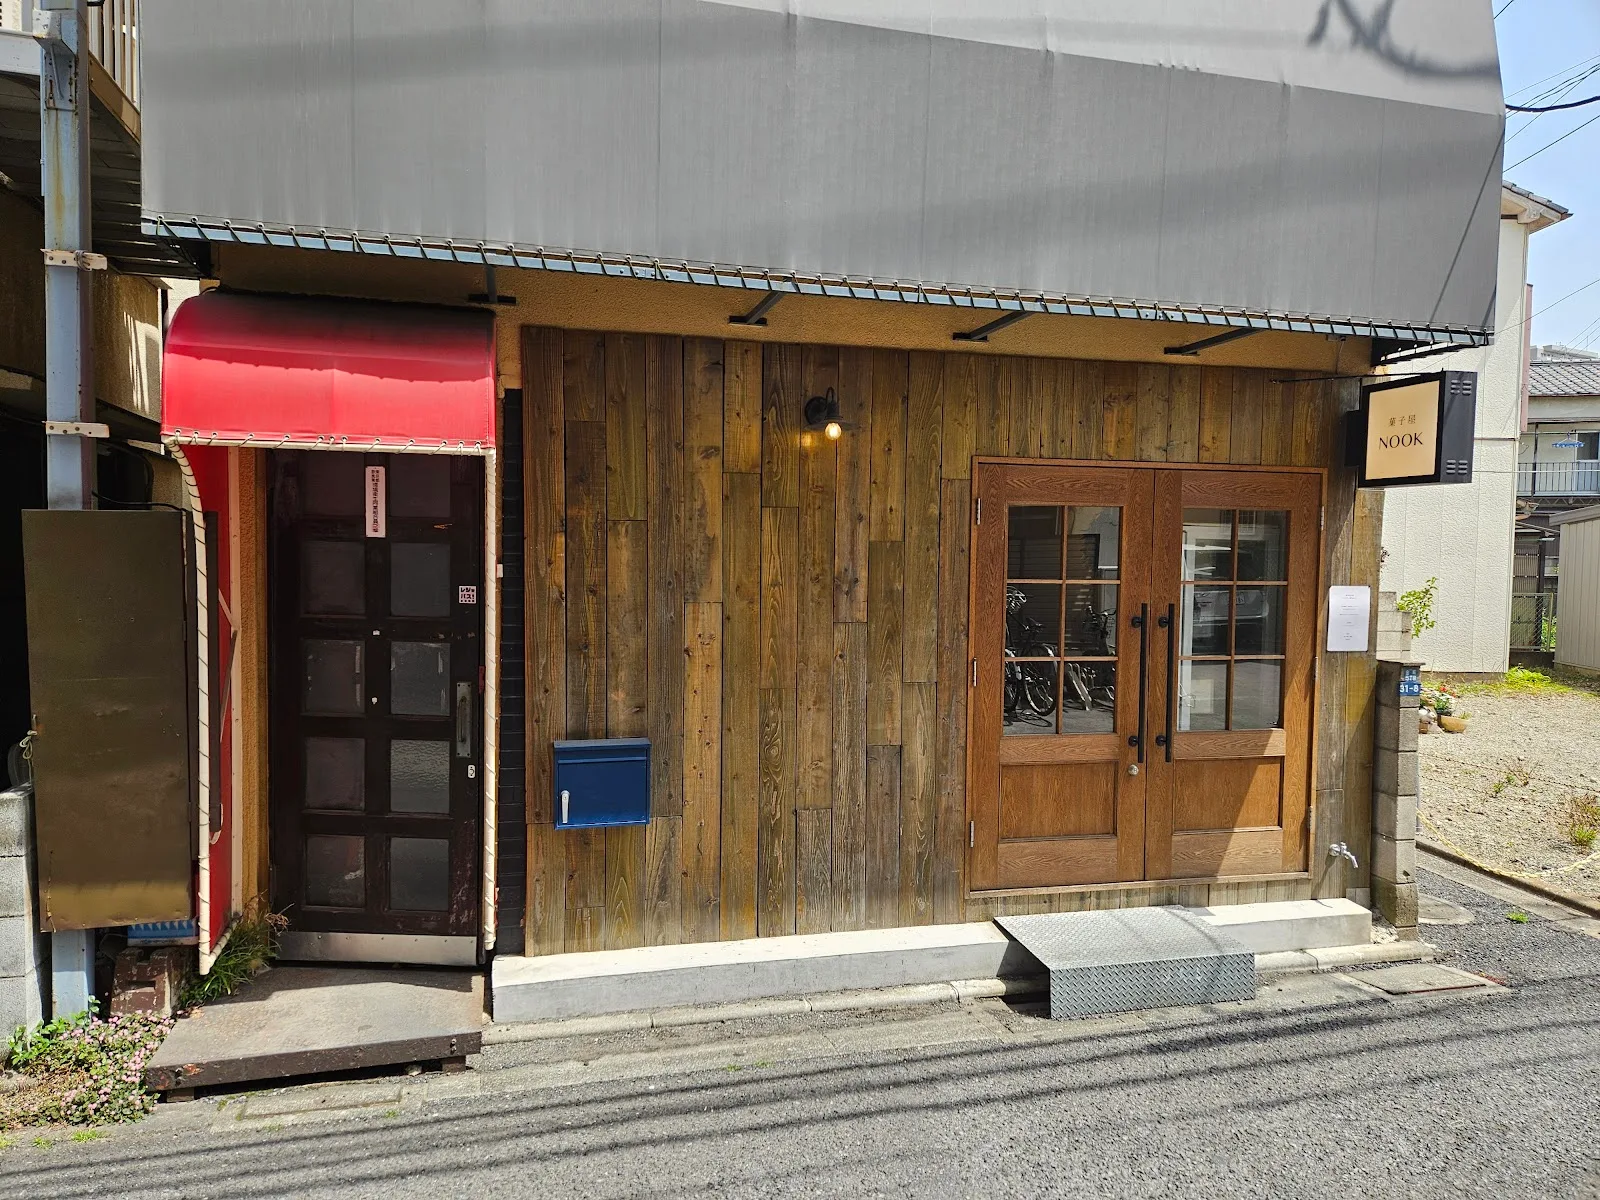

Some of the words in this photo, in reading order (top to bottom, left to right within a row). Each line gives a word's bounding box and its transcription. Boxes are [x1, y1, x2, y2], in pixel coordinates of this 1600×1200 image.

[1388, 414, 1416, 427] 菓子屋
[1378, 431, 1423, 450] NOOK
[1399, 684, 1419, 693] 31-8
